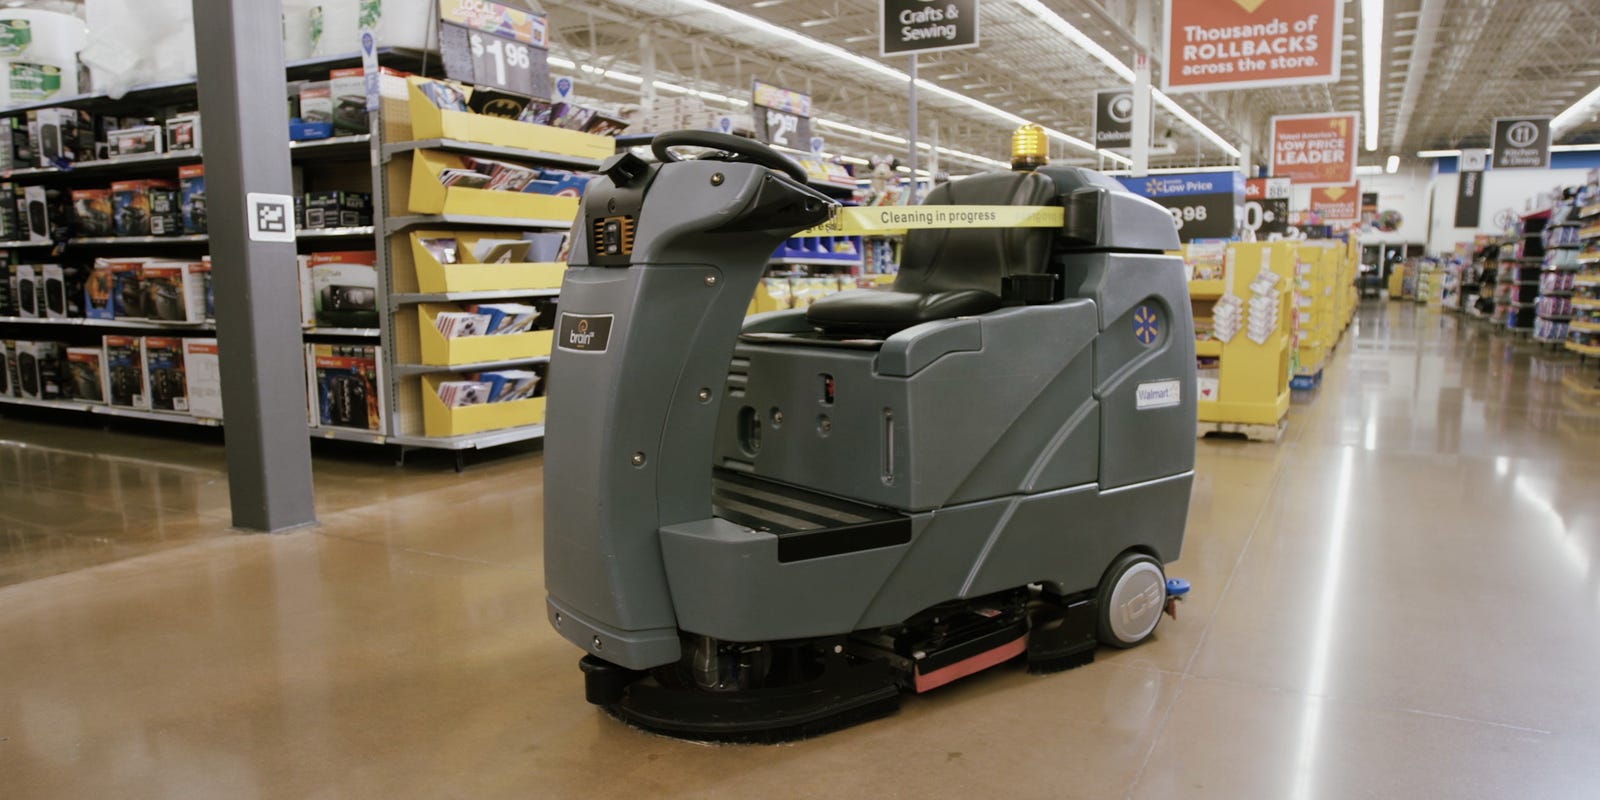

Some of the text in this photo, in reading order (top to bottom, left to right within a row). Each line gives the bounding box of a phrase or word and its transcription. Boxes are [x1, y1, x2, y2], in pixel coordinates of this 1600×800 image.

[899, 4, 959, 25] Crafts &
[901, 23, 957, 42] Sewing
[1184, 14, 1319, 42] Thousands of
[1183, 34, 1319, 61] ROLLBACKS
[1182, 55, 1319, 76] across the store.
[1277, 138, 1345, 152] LOW PRICE
[1277, 149, 1345, 165] LEADER
[1163, 180, 1214, 194] Low Price
[880, 210, 996, 225] Cleaning in progress
[1138, 388, 1169, 401] Walmart
